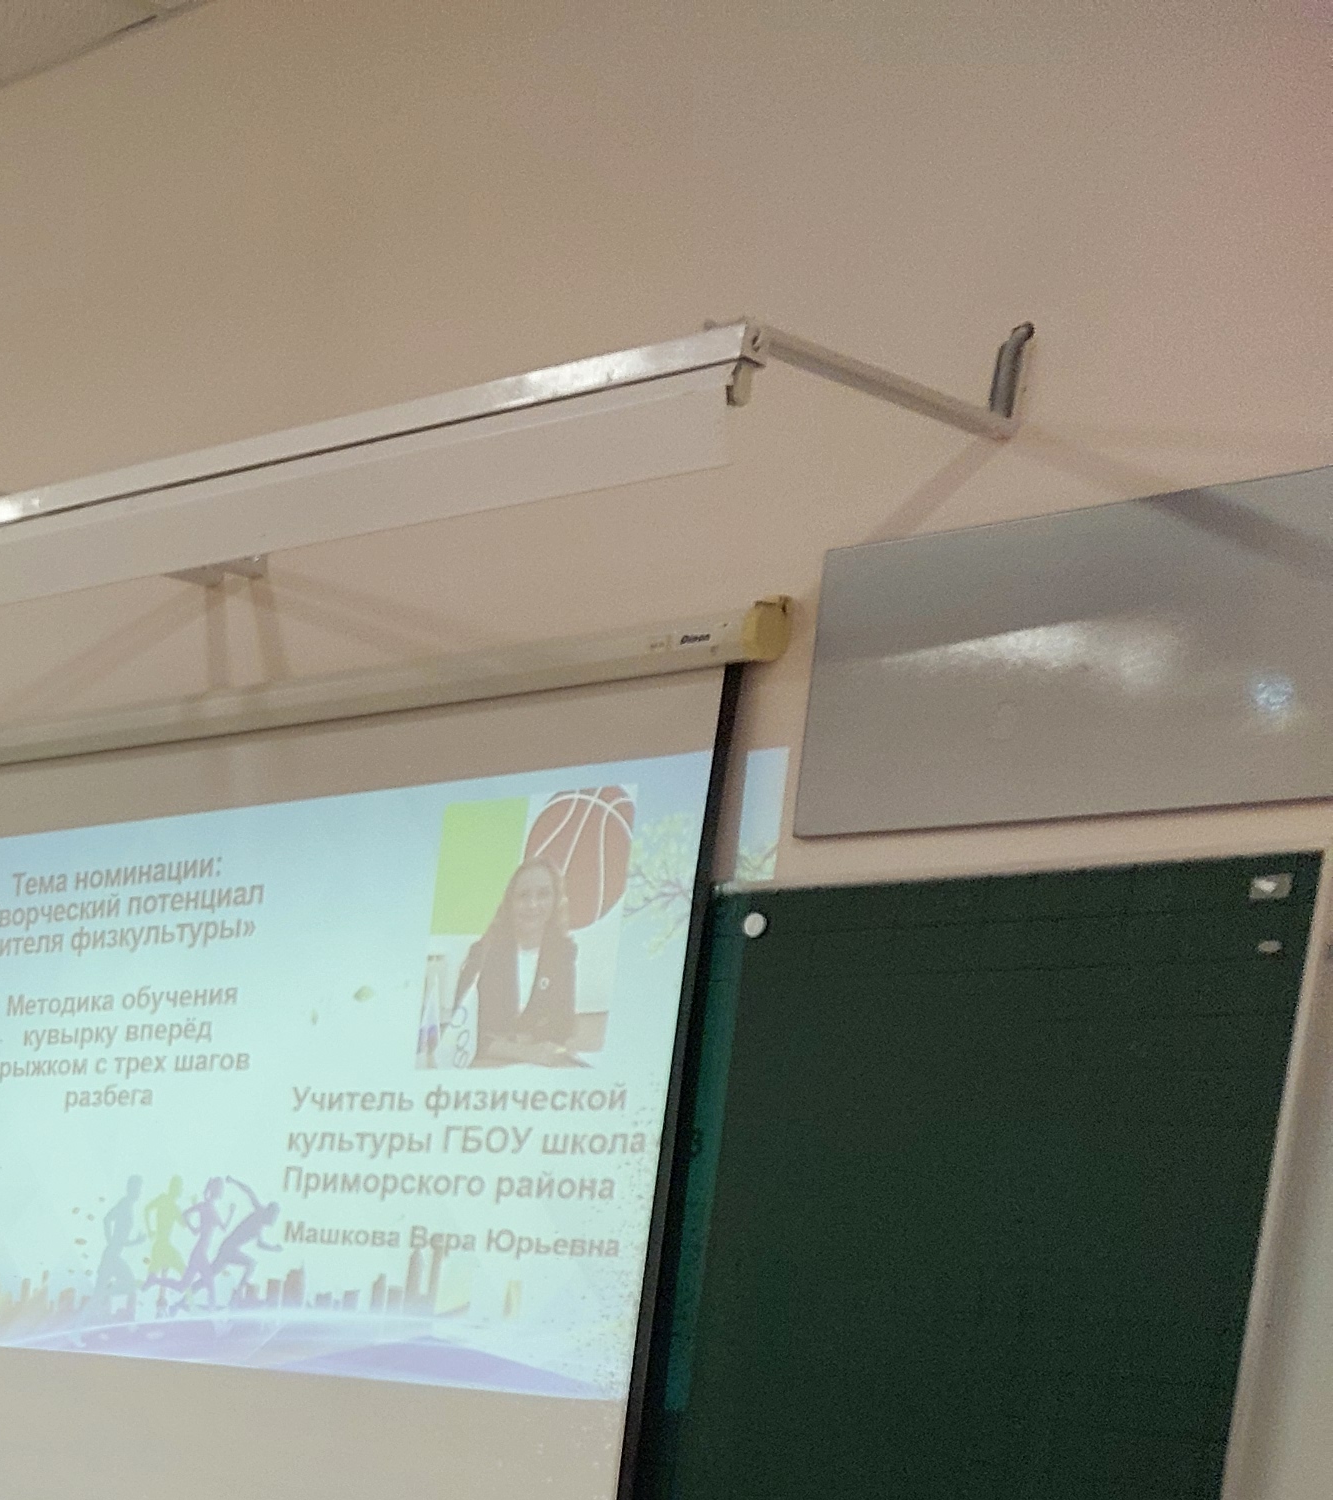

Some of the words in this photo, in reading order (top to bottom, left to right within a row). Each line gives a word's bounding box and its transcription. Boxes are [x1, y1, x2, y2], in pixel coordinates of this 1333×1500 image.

[12, 871, 67, 897] Тема
[74, 856, 223, 891] номинации:
[127, 884, 265, 916] потенциал
[70, 918, 256, 956] физкультуры»
[6, 994, 114, 1018] Методика
[121, 985, 239, 1014] обучения
[23, 1024, 118, 1051] кувырку
[125, 1017, 213, 1046] вперёд
[95, 1057, 108, 1074] с
[114, 1055, 167, 1079] трех
[174, 1052, 251, 1073] шагов
[64, 1083, 153, 1112] разбега
[292, 1085, 415, 1112] Учитель
[425, 1083, 628, 1118] физической
[286, 1130, 432, 1158] культуры
[442, 1125, 533, 1154] ГБОУ
[541, 1130, 647, 1155] школа
[283, 1166, 485, 1199] Приморского
[494, 1171, 616, 1204] района
[284, 1220, 400, 1249] Машкова
[410, 1225, 476, 1253] Вера
[486, 1228, 620, 1259] Юрьевна
